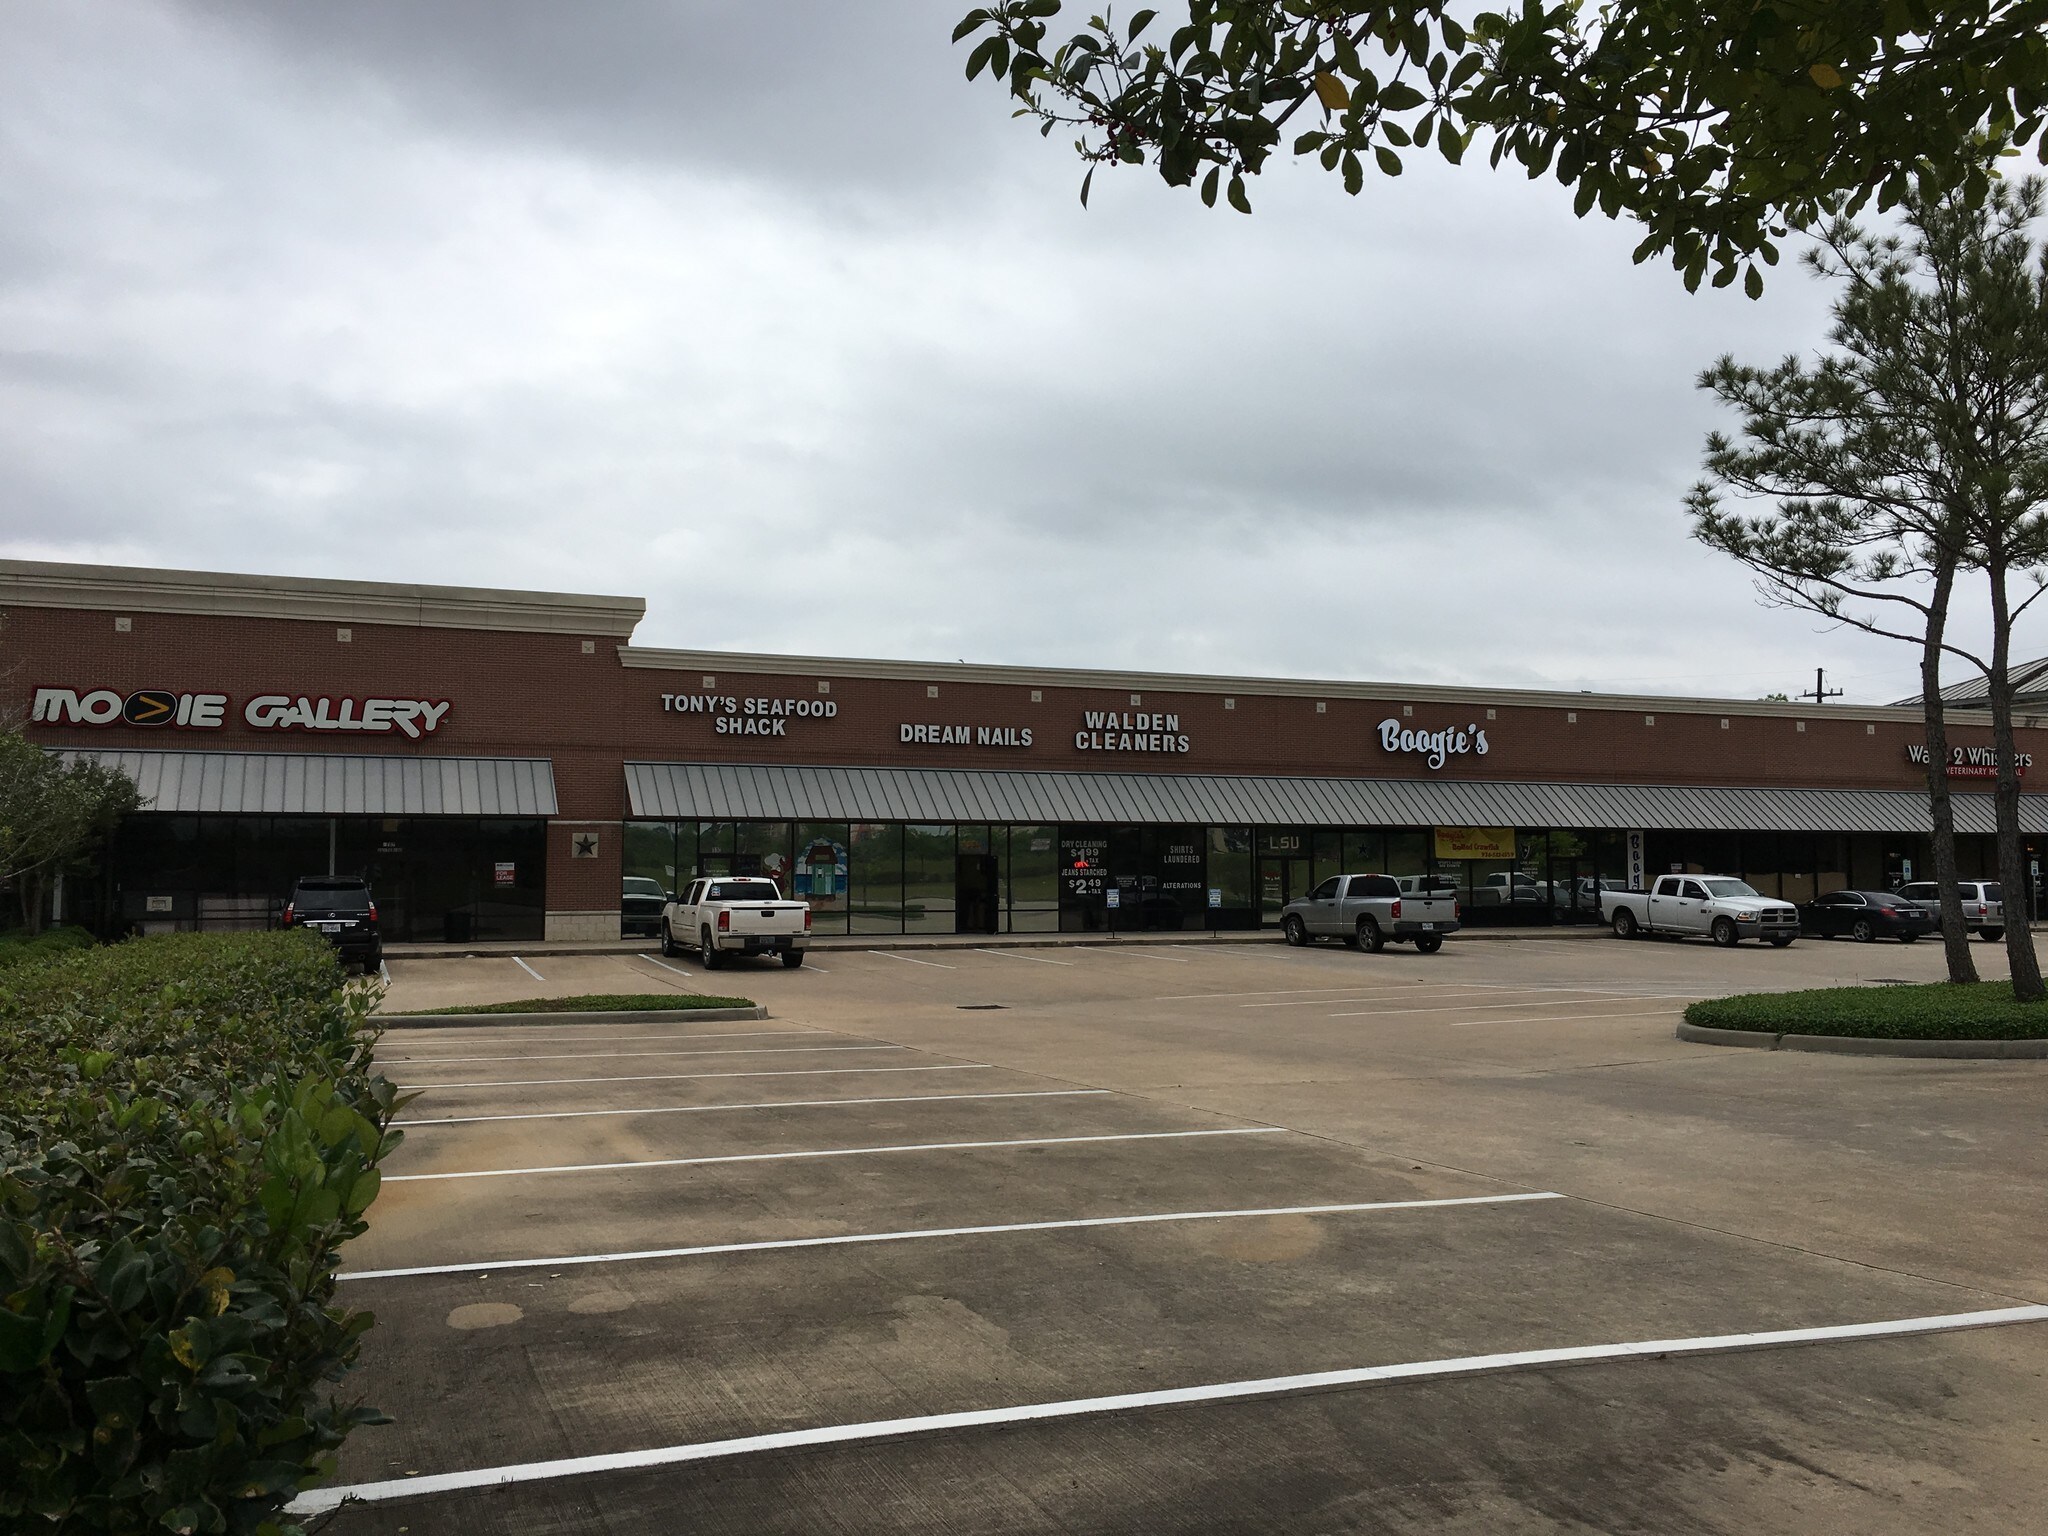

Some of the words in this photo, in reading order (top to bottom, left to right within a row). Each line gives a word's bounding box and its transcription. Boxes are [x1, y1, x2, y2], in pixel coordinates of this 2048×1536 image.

[661, 693, 737, 714] TONY'S
[743, 697, 838, 717] SEAFOOD
[244, 695, 450, 739] GALLERY
[715, 716, 786, 736] SHACK
[1084, 711, 1179, 732] WALDEN
[900, 723, 970, 744] DREAM
[977, 726, 1033, 747] NAILS
[1075, 731, 1190, 753] CLEANERS
[1376, 718, 1489, 770] Boogie's
[1907, 744, 1949, 764] Wa
[1953, 747, 1963, 765] 2
[1945, 767, 1986, 776] VETERINARY
[1061, 840, 1074, 848] DRY
[1075, 840, 1107, 848] CLEANING
[1169, 845, 1194, 854] SHIRTS
[1269, 836, 1300, 849] LSU
[1164, 855, 1200, 864] LAUNDERED
[1061, 868, 1079, 876] JEANS
[1079, 868, 1107, 876] STARCHED
